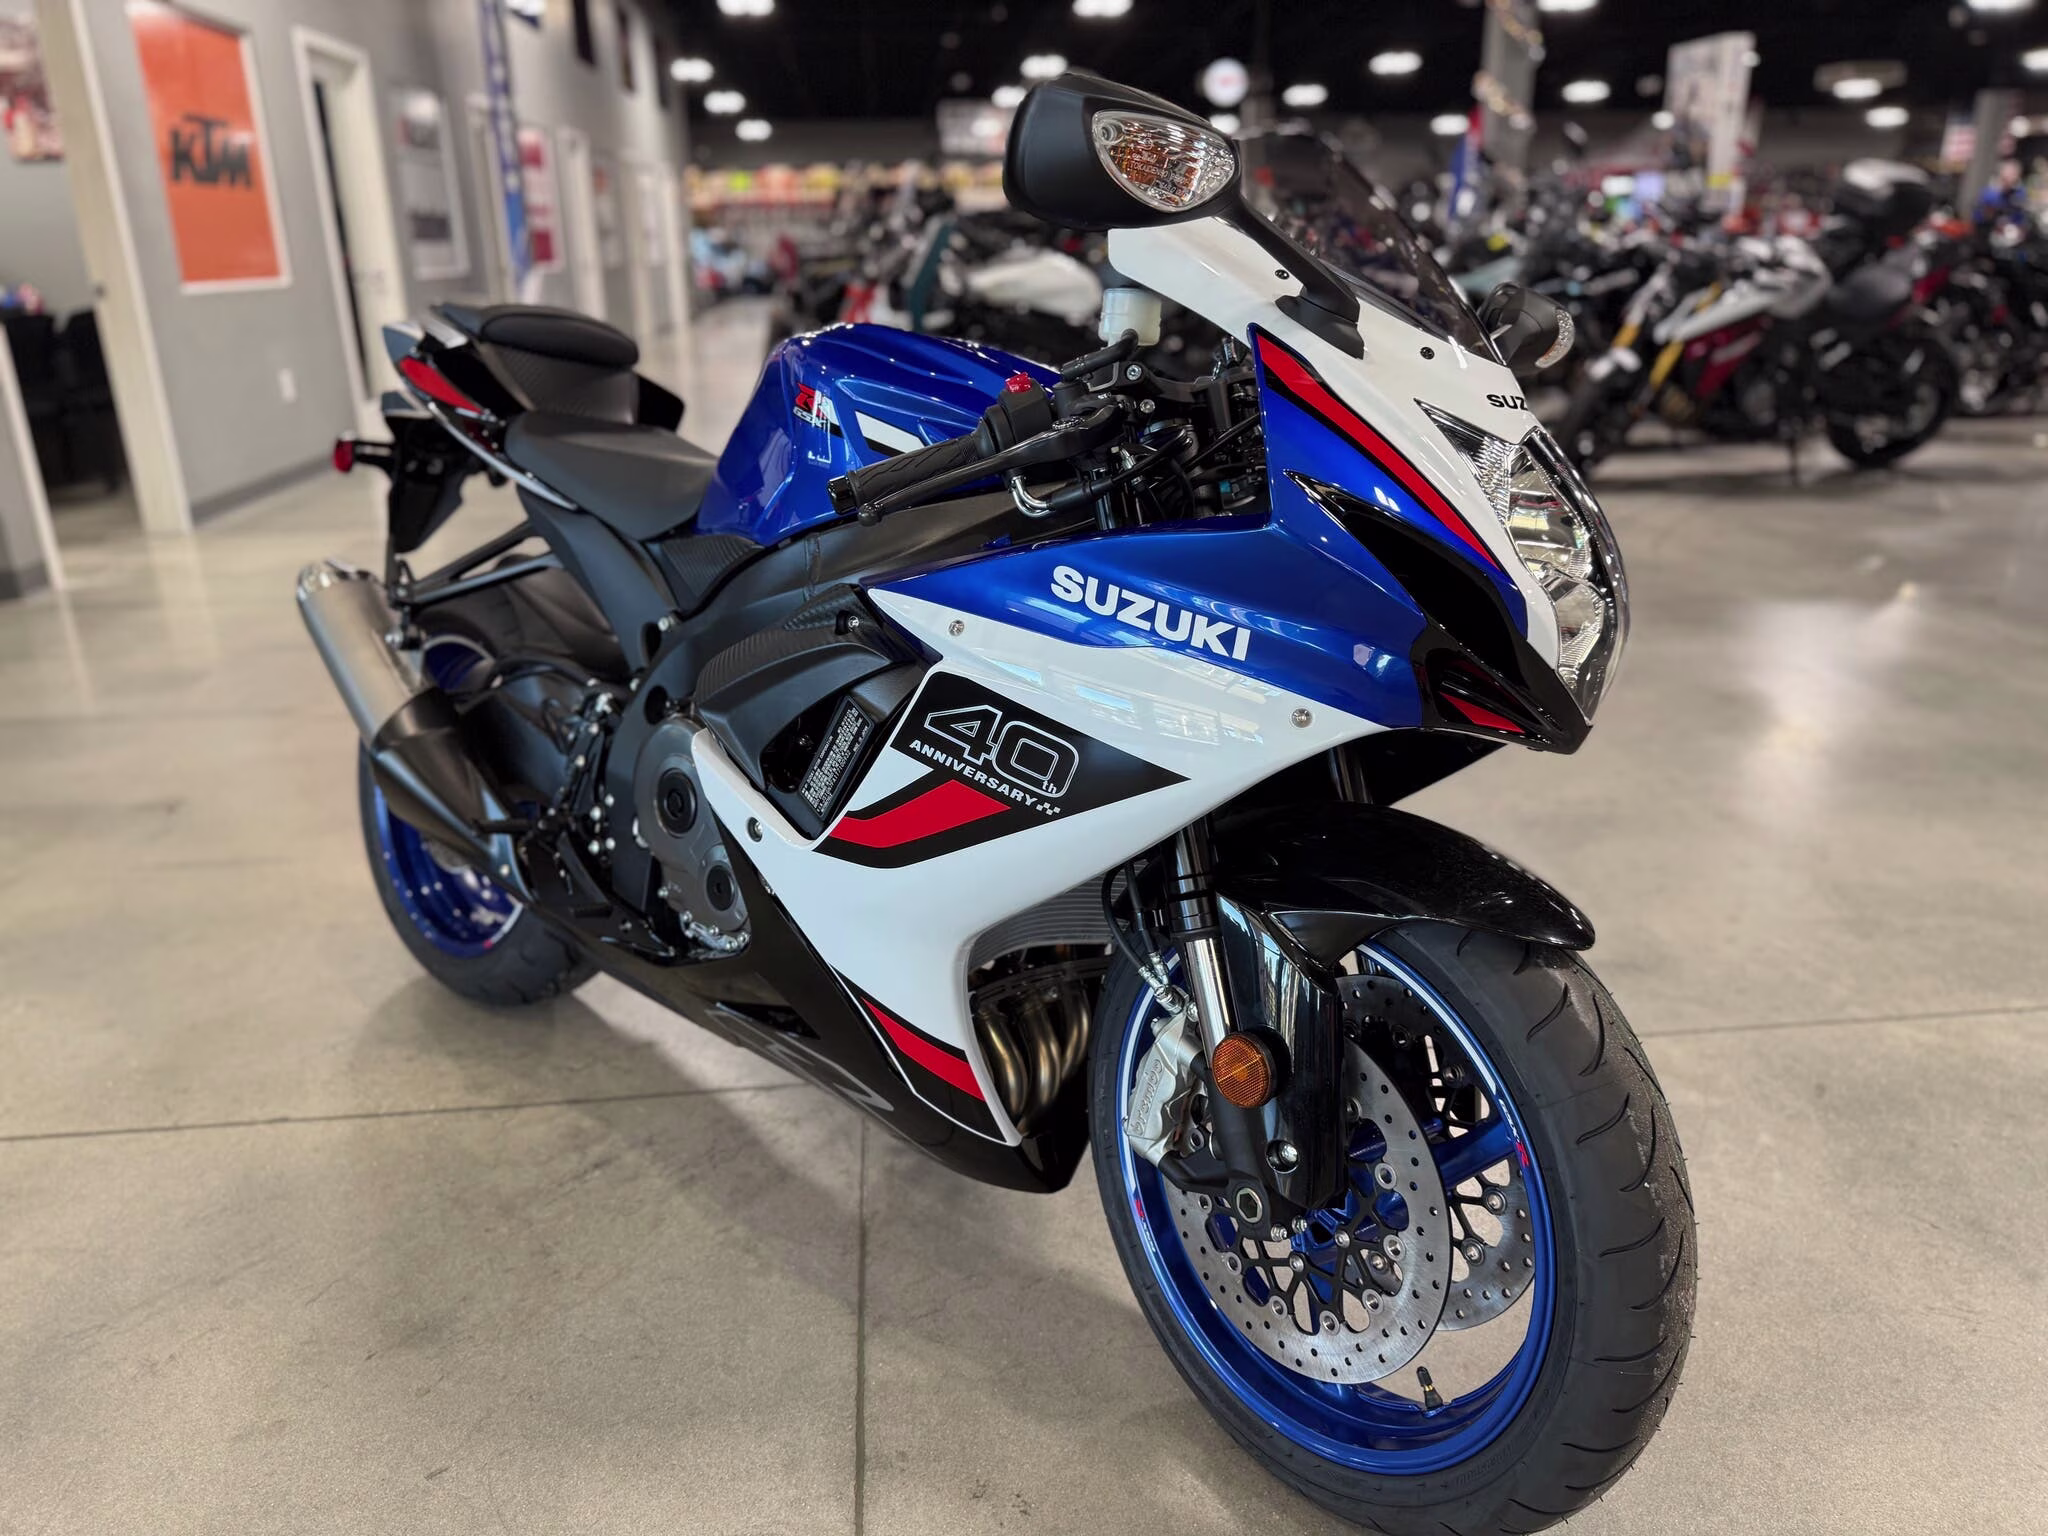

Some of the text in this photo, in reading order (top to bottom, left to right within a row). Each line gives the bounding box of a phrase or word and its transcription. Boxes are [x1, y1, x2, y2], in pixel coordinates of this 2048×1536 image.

[170, 112, 251, 190] KTM
[1050, 565, 1251, 662] SUZUKI
[909, 739, 1038, 806] ANNIVERSARY
[1130, 1059, 1162, 1136] brembo
